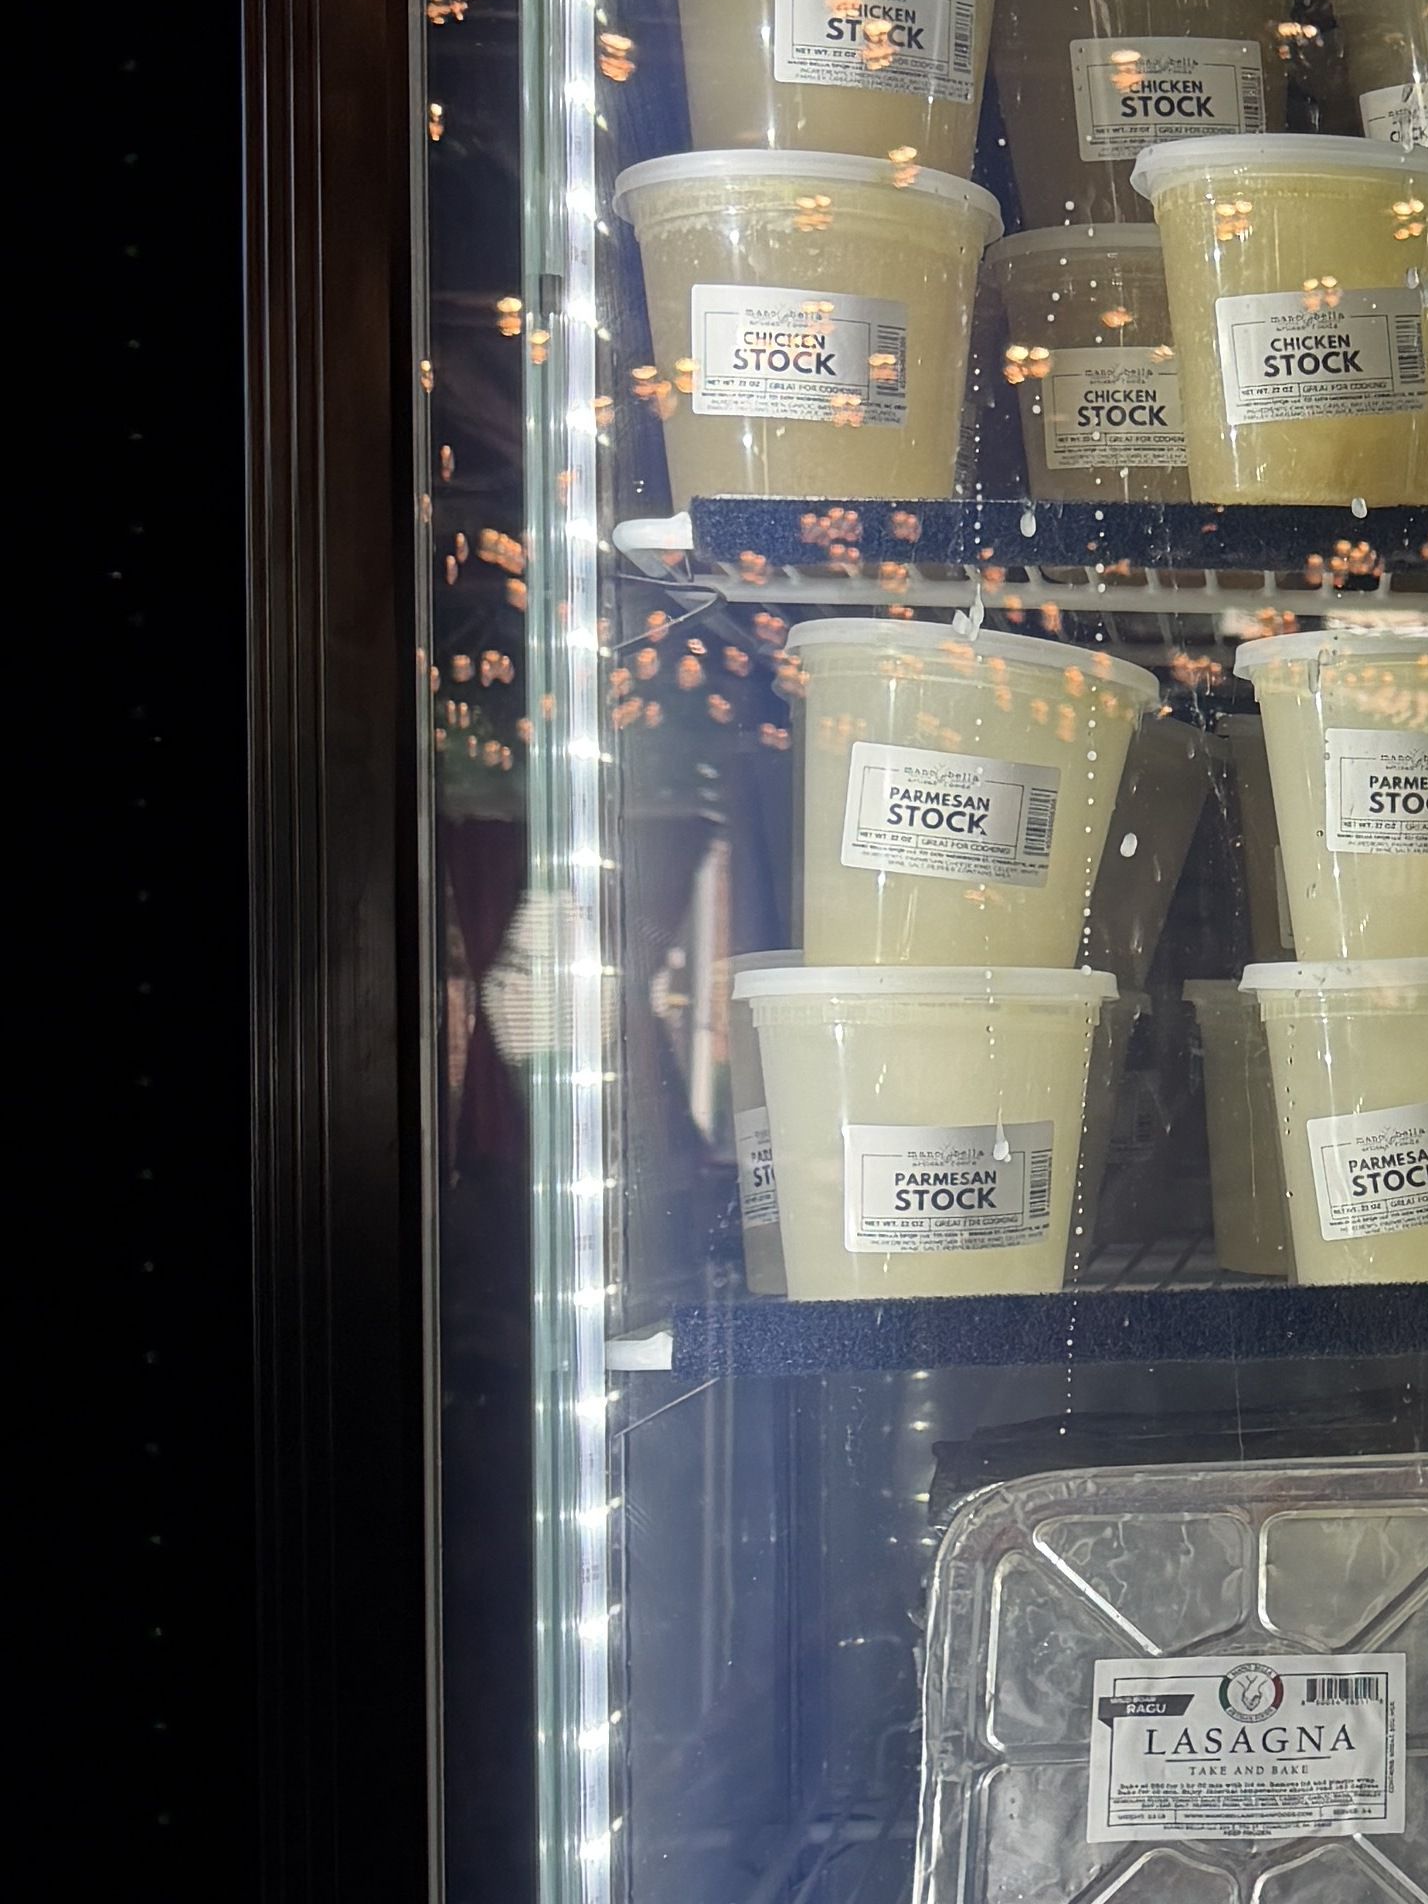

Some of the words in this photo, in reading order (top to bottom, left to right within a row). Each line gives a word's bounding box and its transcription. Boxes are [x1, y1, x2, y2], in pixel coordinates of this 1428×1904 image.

[1121, 95, 1215, 118] STOCK
[743, 329, 826, 349] CHICKEN
[1271, 334, 1351, 352] CHICKEN
[733, 349, 836, 376] STOCK
[1264, 350, 1363, 377] STOCK
[1083, 388, 1157, 404] CHICKEN
[1077, 404, 1168, 428] STOCK
[889, 787, 990, 812] PARMESAN
[887, 803, 988, 836] STOCK
[894, 1169, 998, 1188] PARMESAN
[894, 1184, 998, 1212] STOCK
[1126, 1703, 1167, 1715] RAGU
[1144, 1723, 1356, 1757] LASAGNA
[1189, 1766, 1228, 1777] TAKE
[1234, 1765, 1265, 1776] AND
[1271, 1764, 1309, 1776] BAKE
